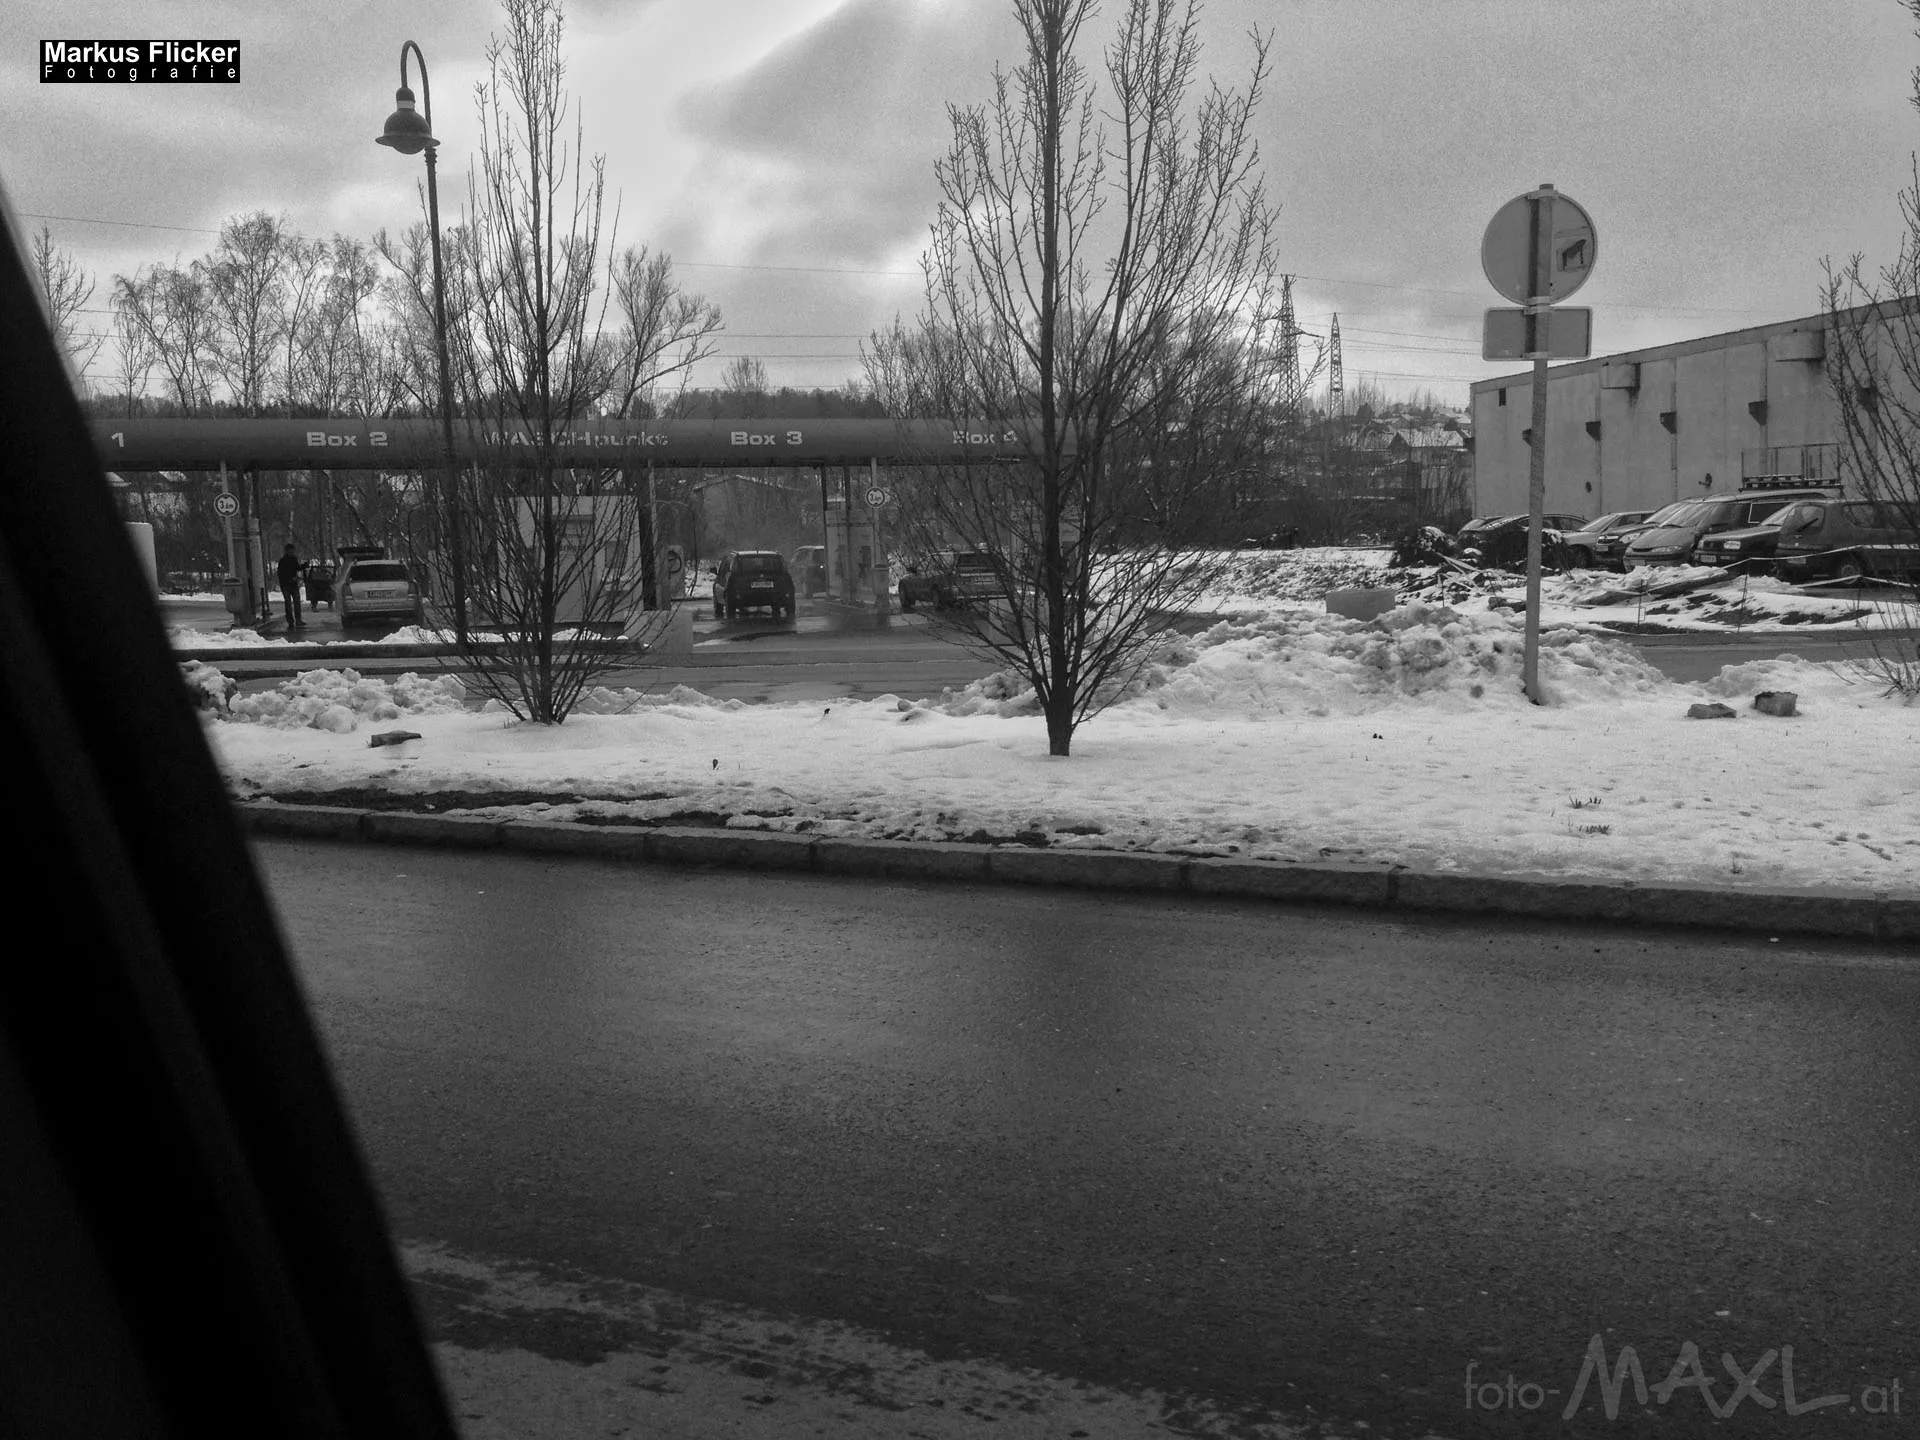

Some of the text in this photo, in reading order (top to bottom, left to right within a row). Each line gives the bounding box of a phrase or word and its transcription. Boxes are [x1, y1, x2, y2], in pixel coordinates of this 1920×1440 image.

[111, 432, 124, 447] 1
[306, 431, 388, 447] Box 2
[730, 431, 803, 446] Box 3
[953, 430, 996, 444] Box
